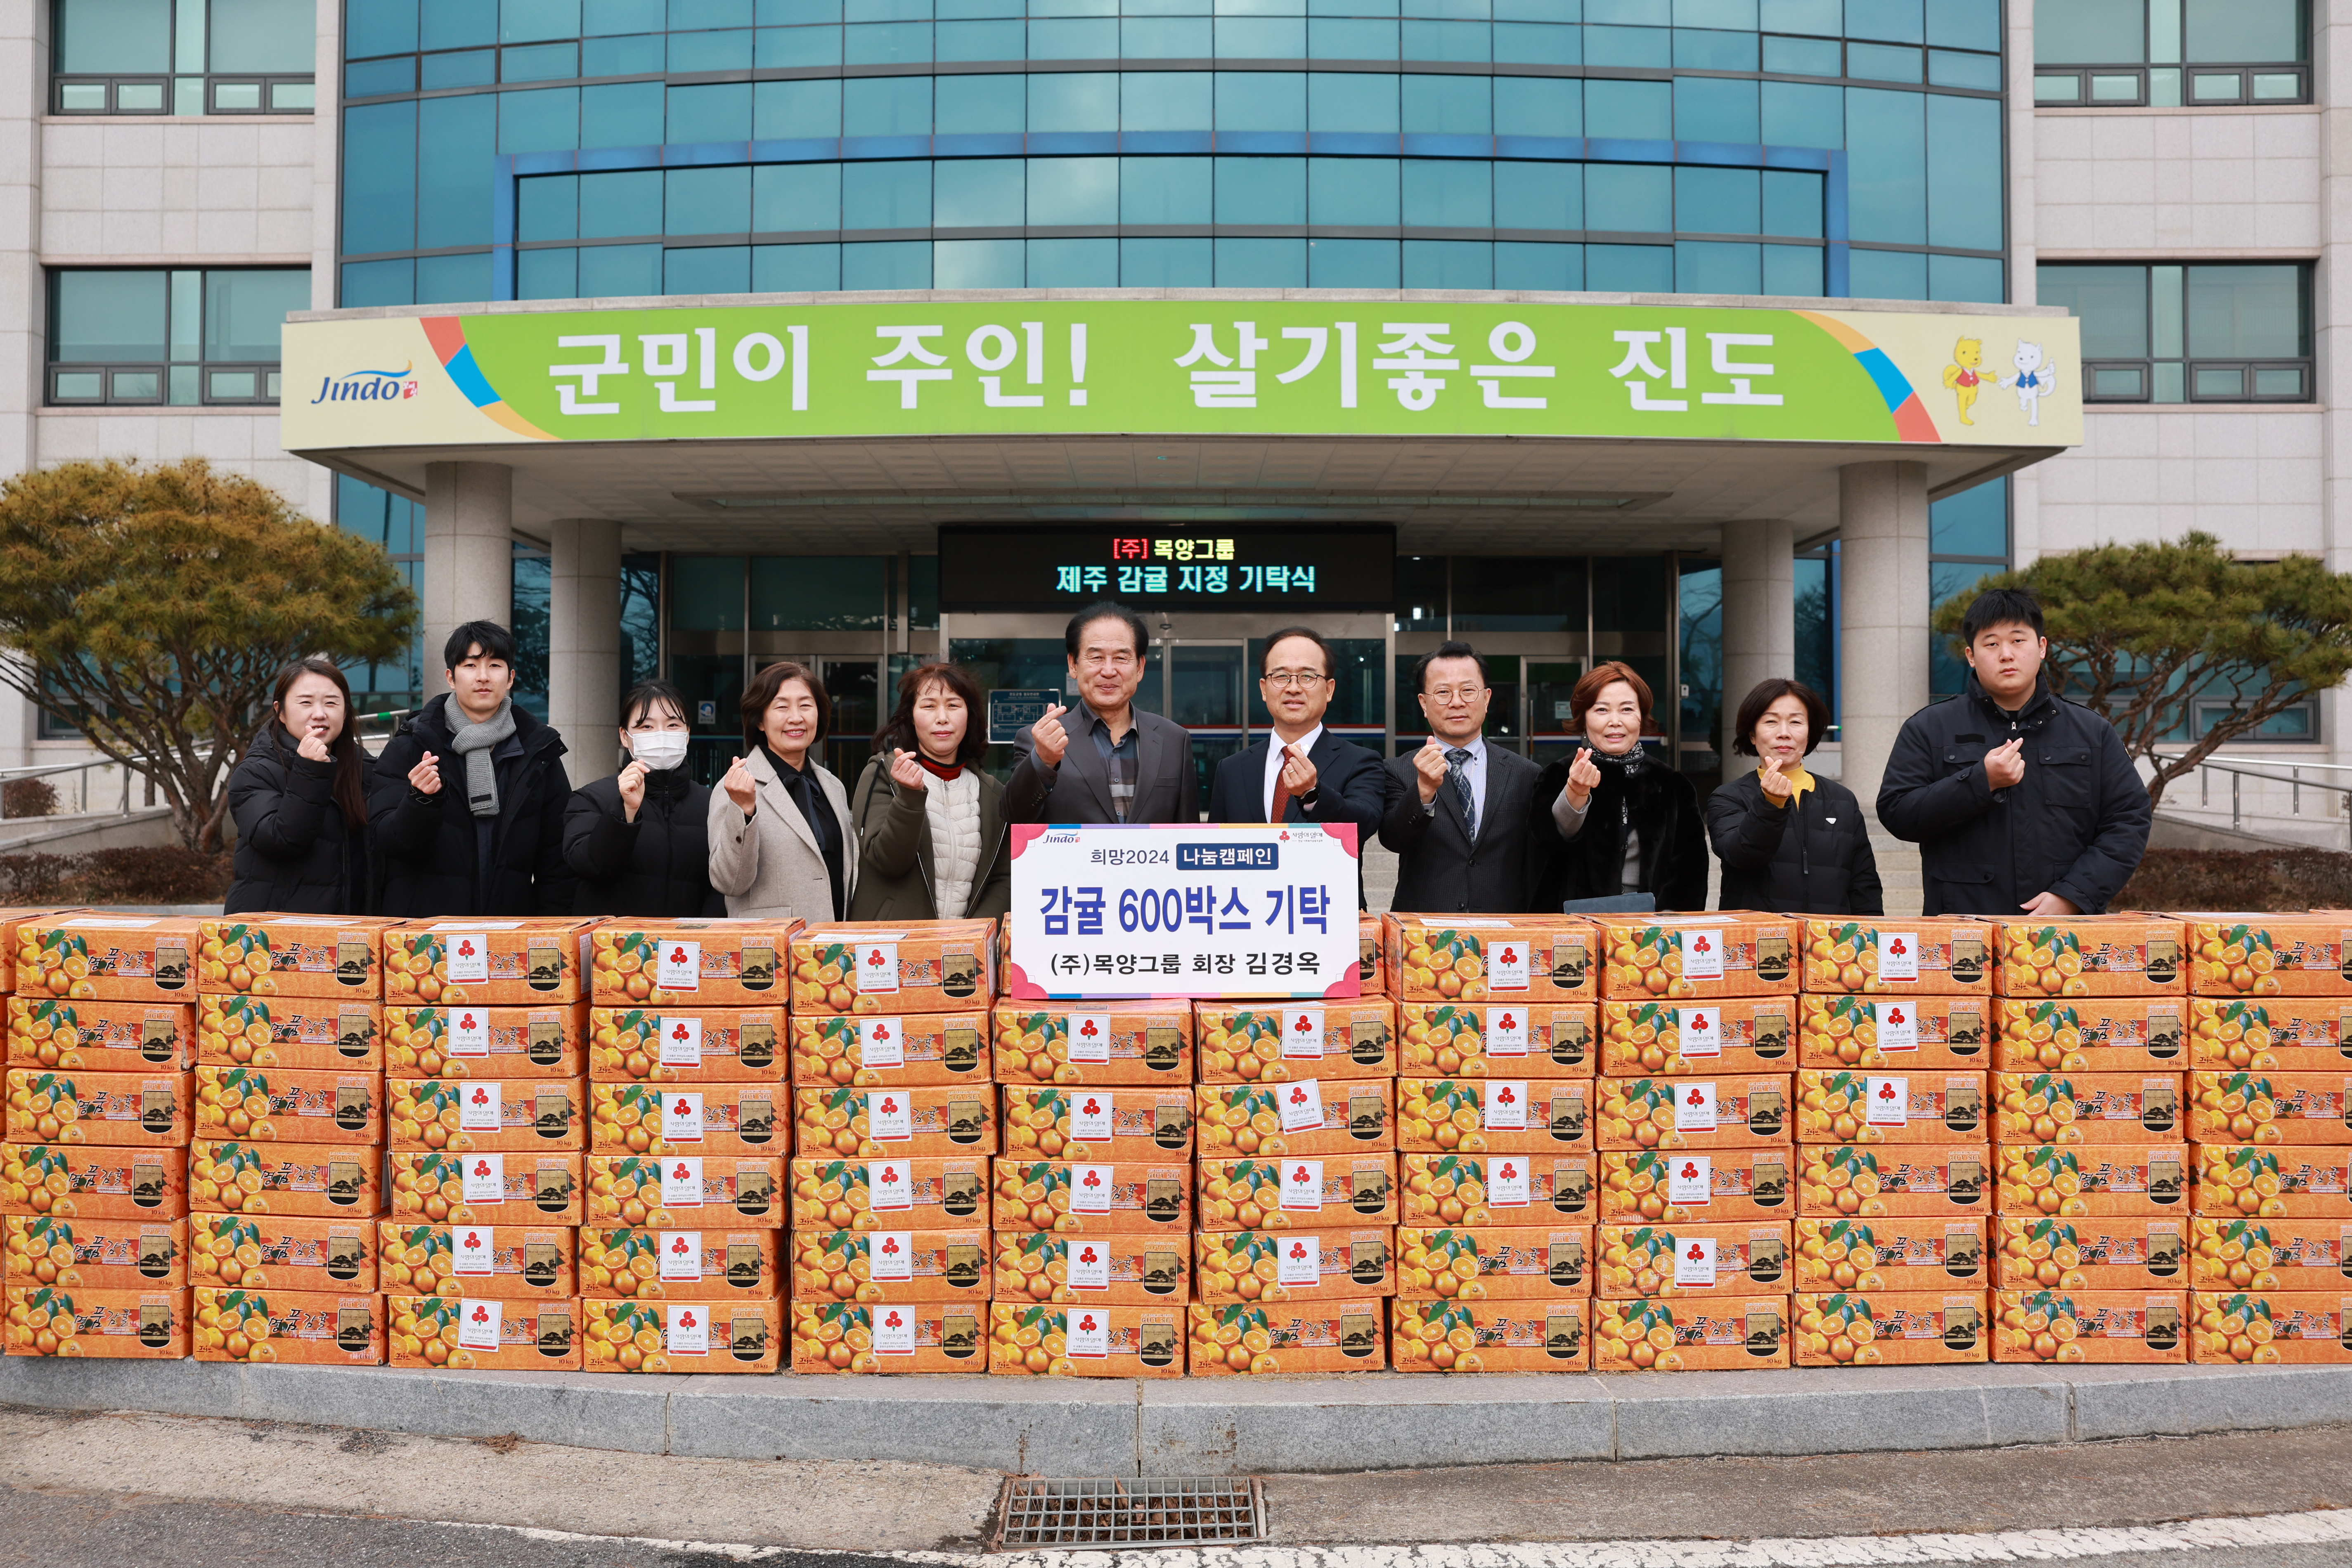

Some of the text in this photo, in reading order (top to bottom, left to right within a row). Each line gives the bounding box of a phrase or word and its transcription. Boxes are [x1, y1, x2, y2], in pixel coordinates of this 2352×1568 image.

[549, 322, 1783, 415] 군민이 주인! 살기좋은 진도
[311, 377, 399, 404] Jindo
[1056, 566, 1315, 593] 제주 감귤 지정 기탁식
[1043, 835, 1074, 844] Jindo
[1091, 848, 1271, 865] 희망2024 나눔캠페인
[1040, 885, 1330, 935] 감귤 600박스 기탁
[1051, 952, 1320, 976] (주)목양그룹 회장 김경옥
